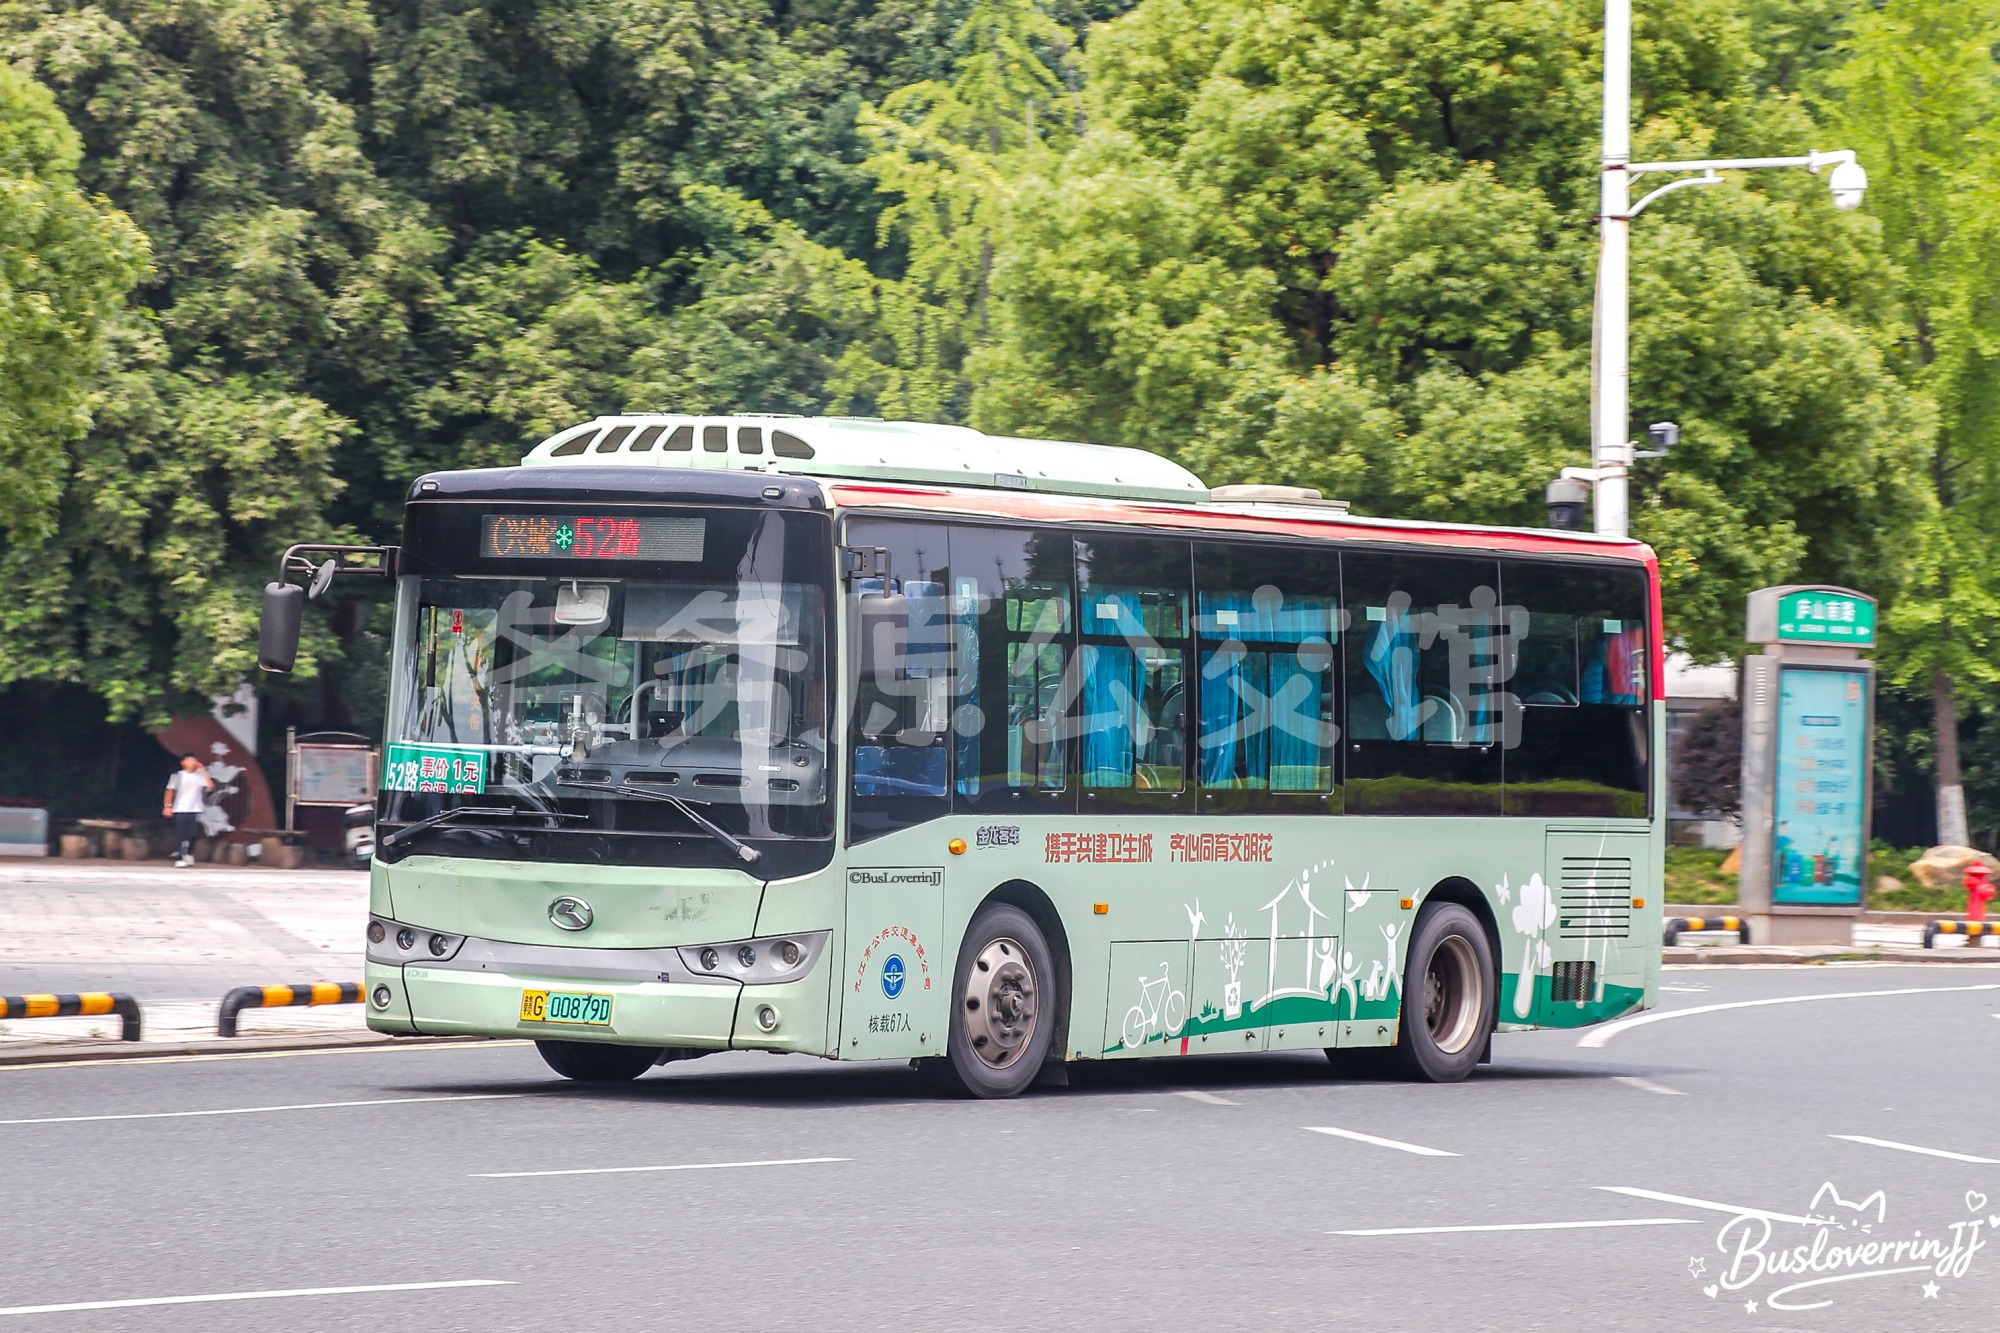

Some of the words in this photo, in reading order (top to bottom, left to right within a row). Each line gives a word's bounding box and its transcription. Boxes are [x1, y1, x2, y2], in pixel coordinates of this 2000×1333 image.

[573, 517, 641, 558] 52路
[387, 760, 418, 792] 52路
[1044, 832, 1153, 863] 携手共建卫生城
[1170, 833, 1273, 863] 齐心同育文明花
[868, 1012, 912, 1034] 核载67人
